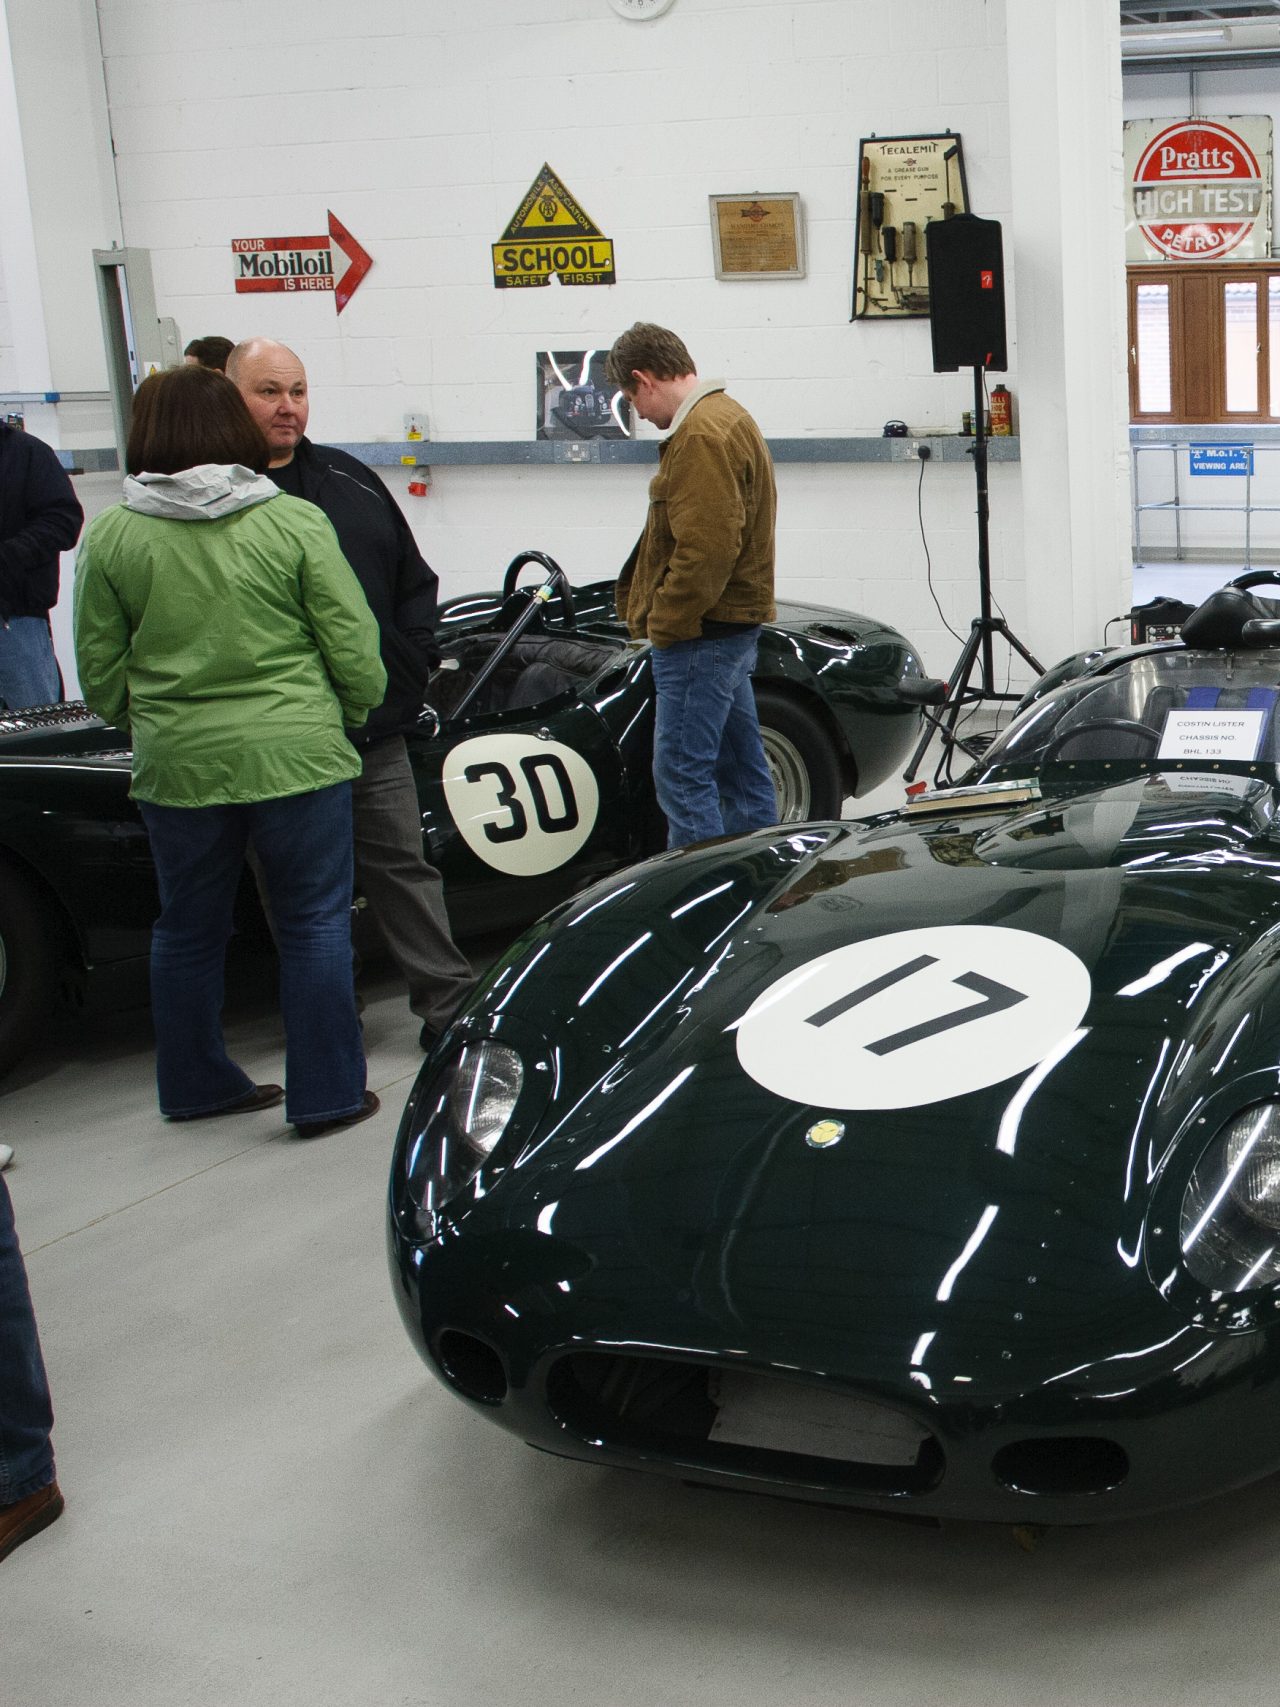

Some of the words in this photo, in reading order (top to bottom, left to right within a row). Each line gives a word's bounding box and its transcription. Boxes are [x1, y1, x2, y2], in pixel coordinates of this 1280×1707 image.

[880, 141, 939, 156] TECALEMIT
[1160, 146, 1235, 176] Pratts
[510, 181, 545, 234] AUTOMOBILE
[1136, 189, 1193, 216] HIGH
[1200, 188, 1258, 213] TEST
[233, 239, 265, 251] YOUR
[1161, 227, 1233, 252] PETROL
[238, 251, 335, 277] Mobiloil
[503, 245, 606, 272] SCHOOL
[284, 279, 296, 290] IS
[300, 278, 332, 290] HERE
[506, 276, 551, 286] SAFET
[563, 273, 602, 283] FIRST
[1193, 462, 1226, 470] VIEWING
[464, 753, 579, 844] 30
[803, 954, 1030, 1057] 17
